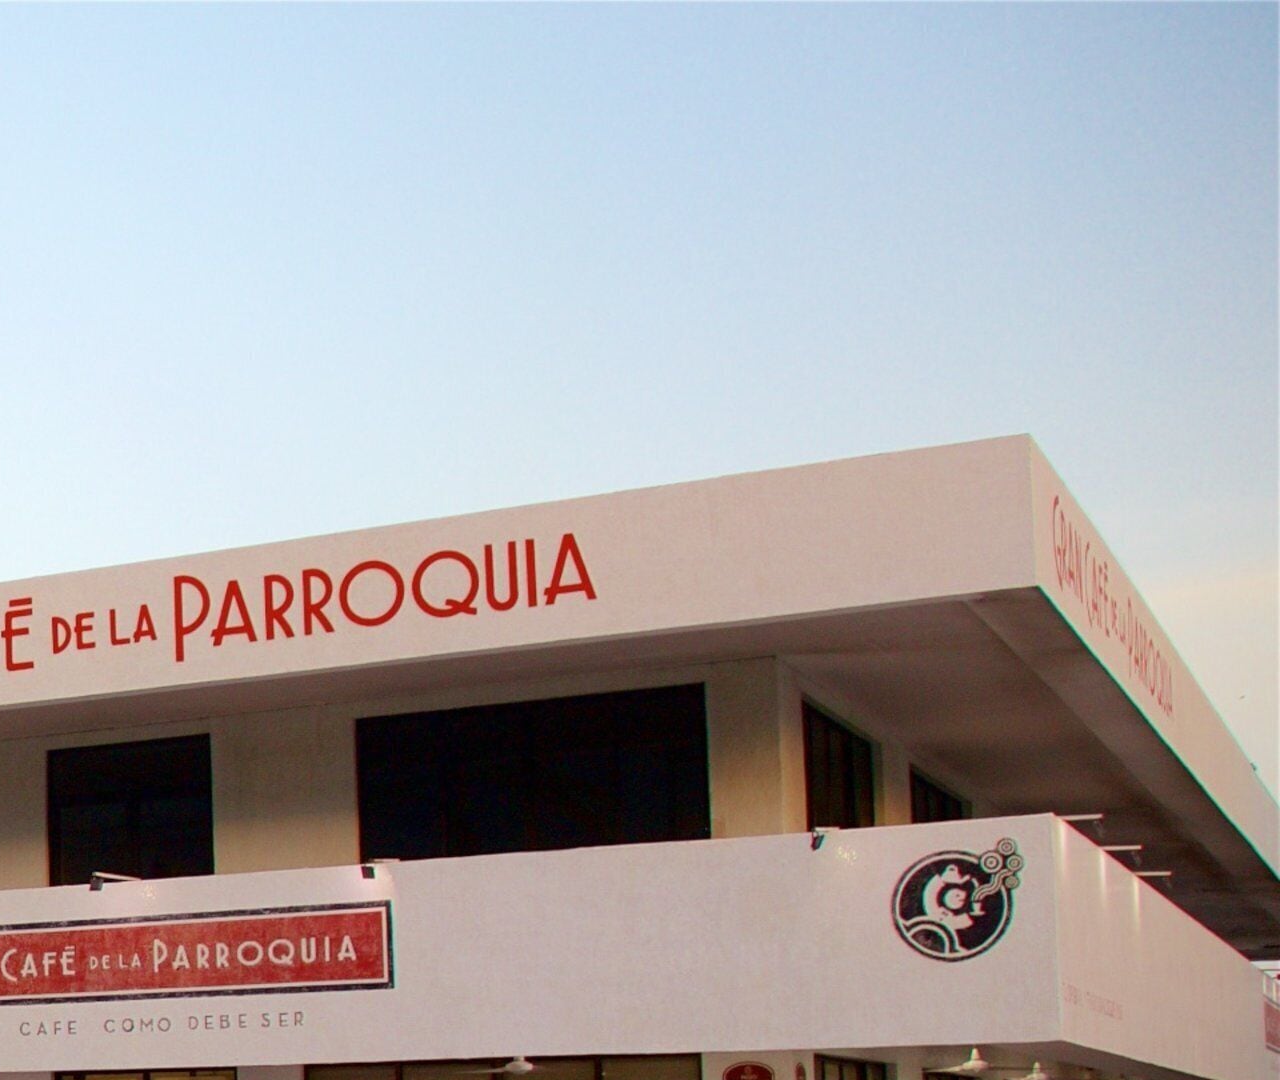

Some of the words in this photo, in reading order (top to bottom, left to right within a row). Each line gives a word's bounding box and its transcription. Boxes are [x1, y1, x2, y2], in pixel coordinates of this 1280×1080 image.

[1052, 495, 1083, 604] GRAN
[51, 611, 96, 654] DE
[109, 604, 157, 646] LA
[173, 532, 598, 662] PARROQUIA
[0, 945, 76, 982] CAFÉ
[89, 955, 111, 971] DE
[119, 952, 142, 969] LA
[153, 934, 357, 974] PARROQUIA
[19, 1020, 78, 1036] CAFE
[104, 1016, 172, 1034] COMO
[188, 1013, 249, 1031] DEBE
[261, 1011, 306, 1028] SER
